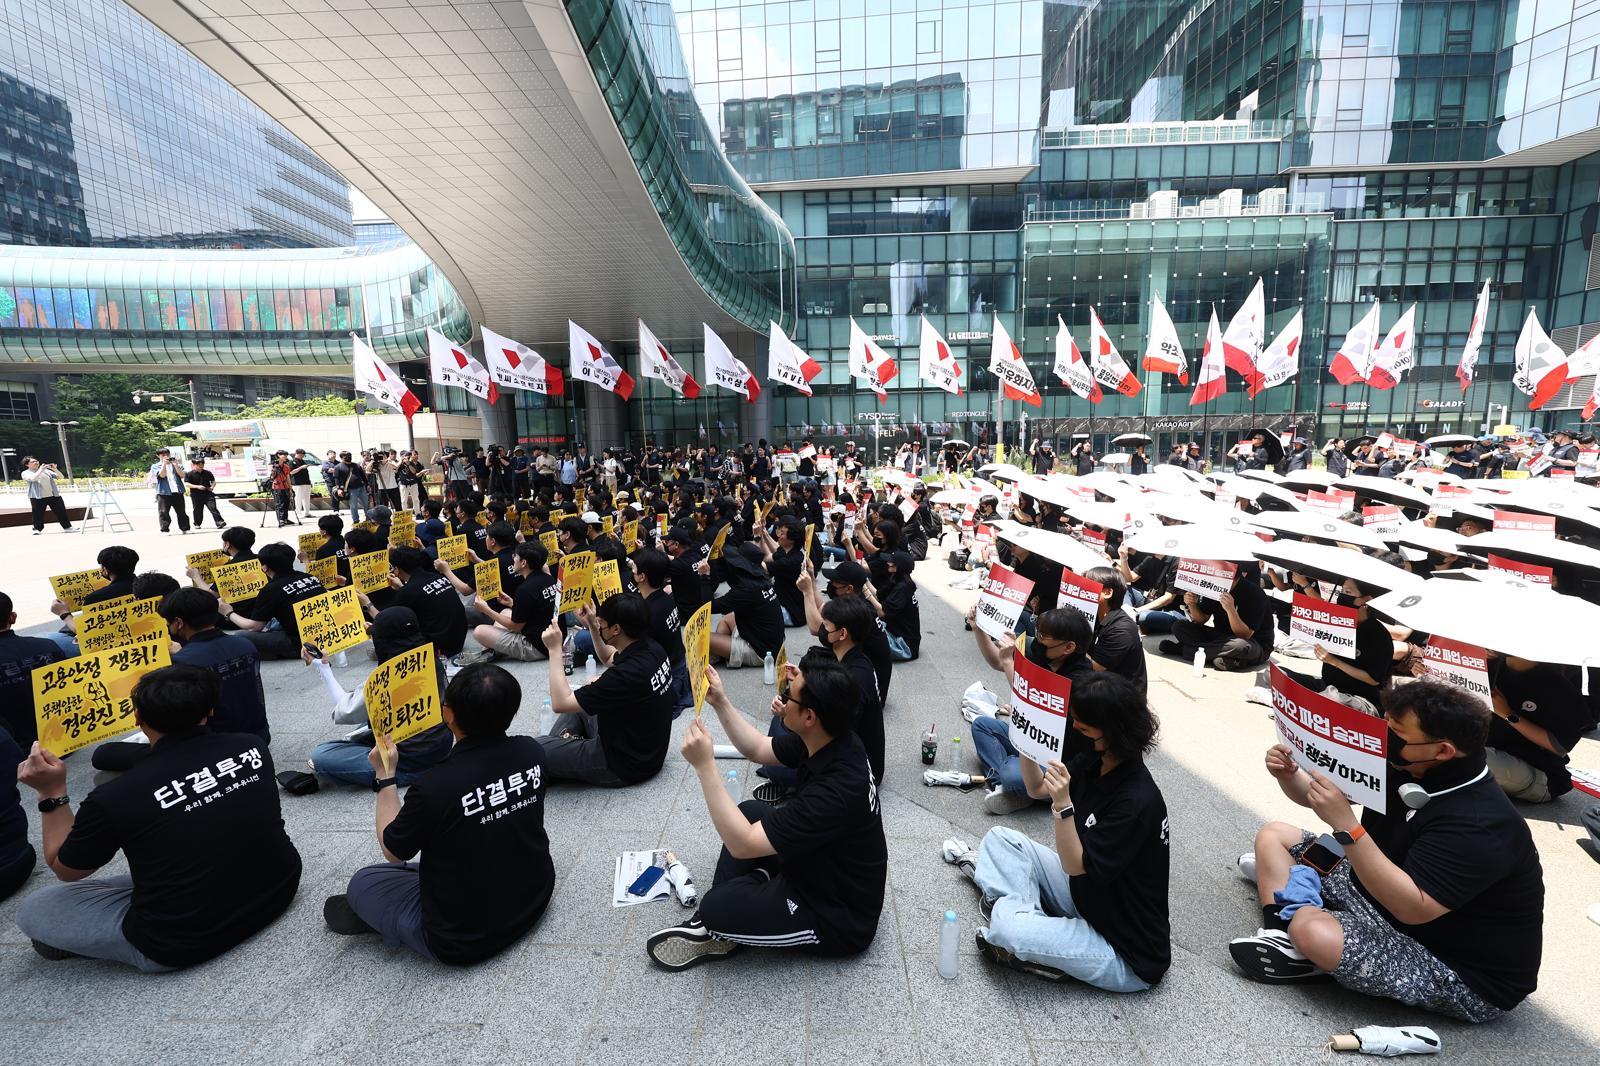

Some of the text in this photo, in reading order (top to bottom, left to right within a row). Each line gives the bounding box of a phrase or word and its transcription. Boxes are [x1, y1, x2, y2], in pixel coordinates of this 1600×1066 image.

[1428, 400, 1463, 408] SALADY
[858, 412, 882, 421] FYSD
[879, 429, 897, 438] FELT
[216, 561, 259, 579] 고용안정 쟁취!
[567, 556, 592, 571] 쟁취!
[601, 562, 616, 576] 쟁취!
[1180, 560, 1199, 572] 카카오
[1199, 564, 1214, 575] 파업
[56, 573, 90, 587] 고용안정
[228, 580, 265, 598] 경영진 퇴진!
[300, 596, 330, 621] 고용안정
[331, 589, 353, 608] 쟁취!
[563, 587, 587, 605] 퇴진!
[1002, 587, 1027, 604] 승리로
[83, 600, 158, 633] 고용안정 쟁취!
[982, 602, 998, 619] 쟁취
[1292, 605, 1355, 627] 카카오 파업 승리로
[84, 632, 115, 649] 무책임한
[302, 621, 323, 638] 무책임한
[314, 619, 363, 650] 경영진 퇴진!
[1291, 620, 1354, 648] 공동교섭 쟁취 하자!
[41, 644, 158, 695] 고용안정 쟁취!
[394, 650, 428, 680] 쟁취!
[1442, 648, 1461, 665] 파업
[1461, 655, 1486, 670] 승리로
[1448, 670, 1467, 689] 쟁취
[1468, 680, 1490, 697] 하자!
[41, 694, 83, 721] 무책임한
[1028, 687, 1065, 714] 승리로
[61, 702, 117, 739] 경영진
[395, 695, 432, 729] 퇴진!
[1271, 685, 1383, 754] 카카오 파업 승리로
[1011, 706, 1031, 735] 쟁취
[1029, 724, 1060, 753] 하자!
[1275, 715, 1304, 753] 공동교섭
[1305, 742, 1338, 774] 쟁취
[1337, 763, 1381, 793] 하자!
[153, 747, 263, 809] 단결투쟁
[461, 764, 541, 817] 단결투쟁
[184, 799, 203, 812] 우리
[480, 813, 493, 825] 우리
